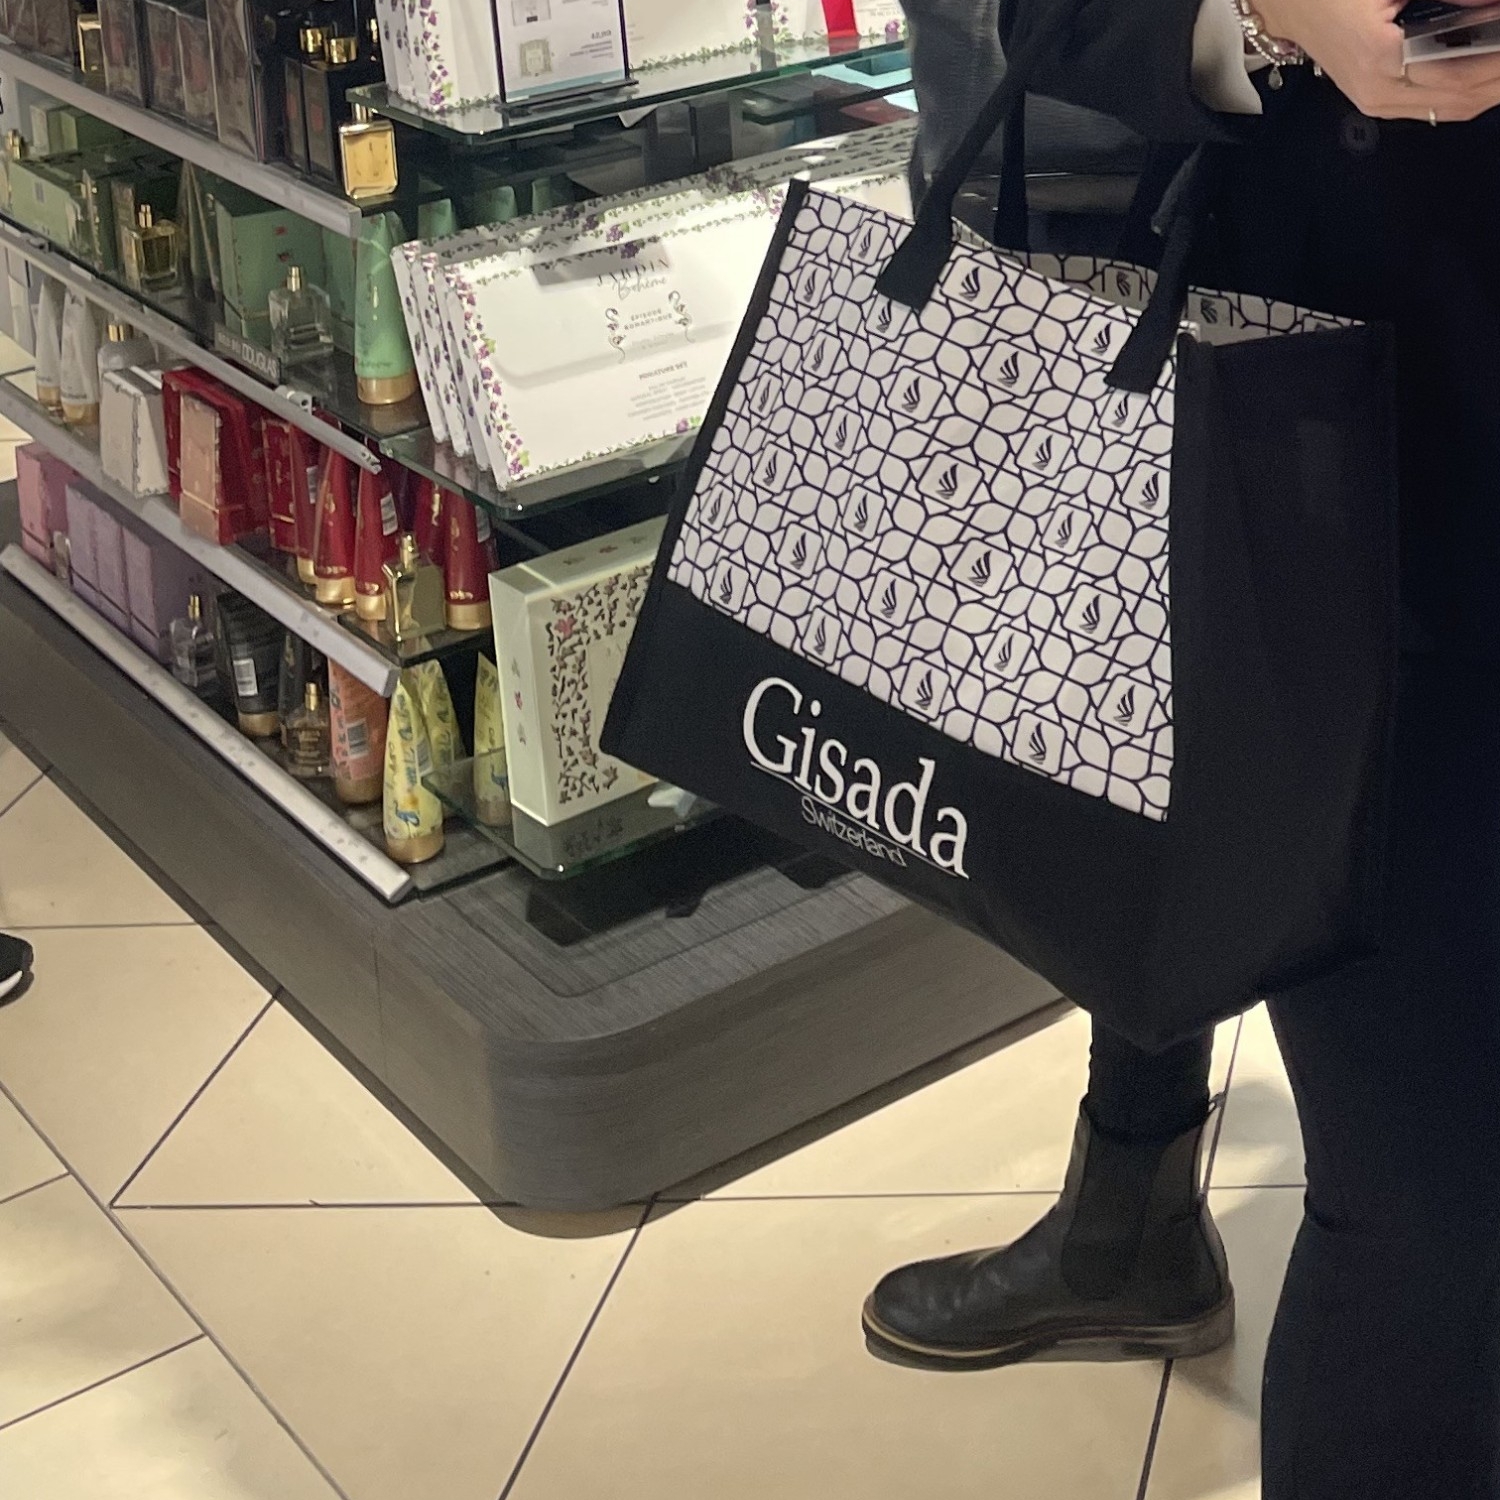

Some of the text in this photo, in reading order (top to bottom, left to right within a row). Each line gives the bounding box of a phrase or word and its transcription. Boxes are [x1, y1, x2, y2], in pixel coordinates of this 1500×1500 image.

[241, 342, 278, 380] DOUGLAS
[742, 676, 970, 880] Gisada
[800, 794, 908, 868] Switzerland
